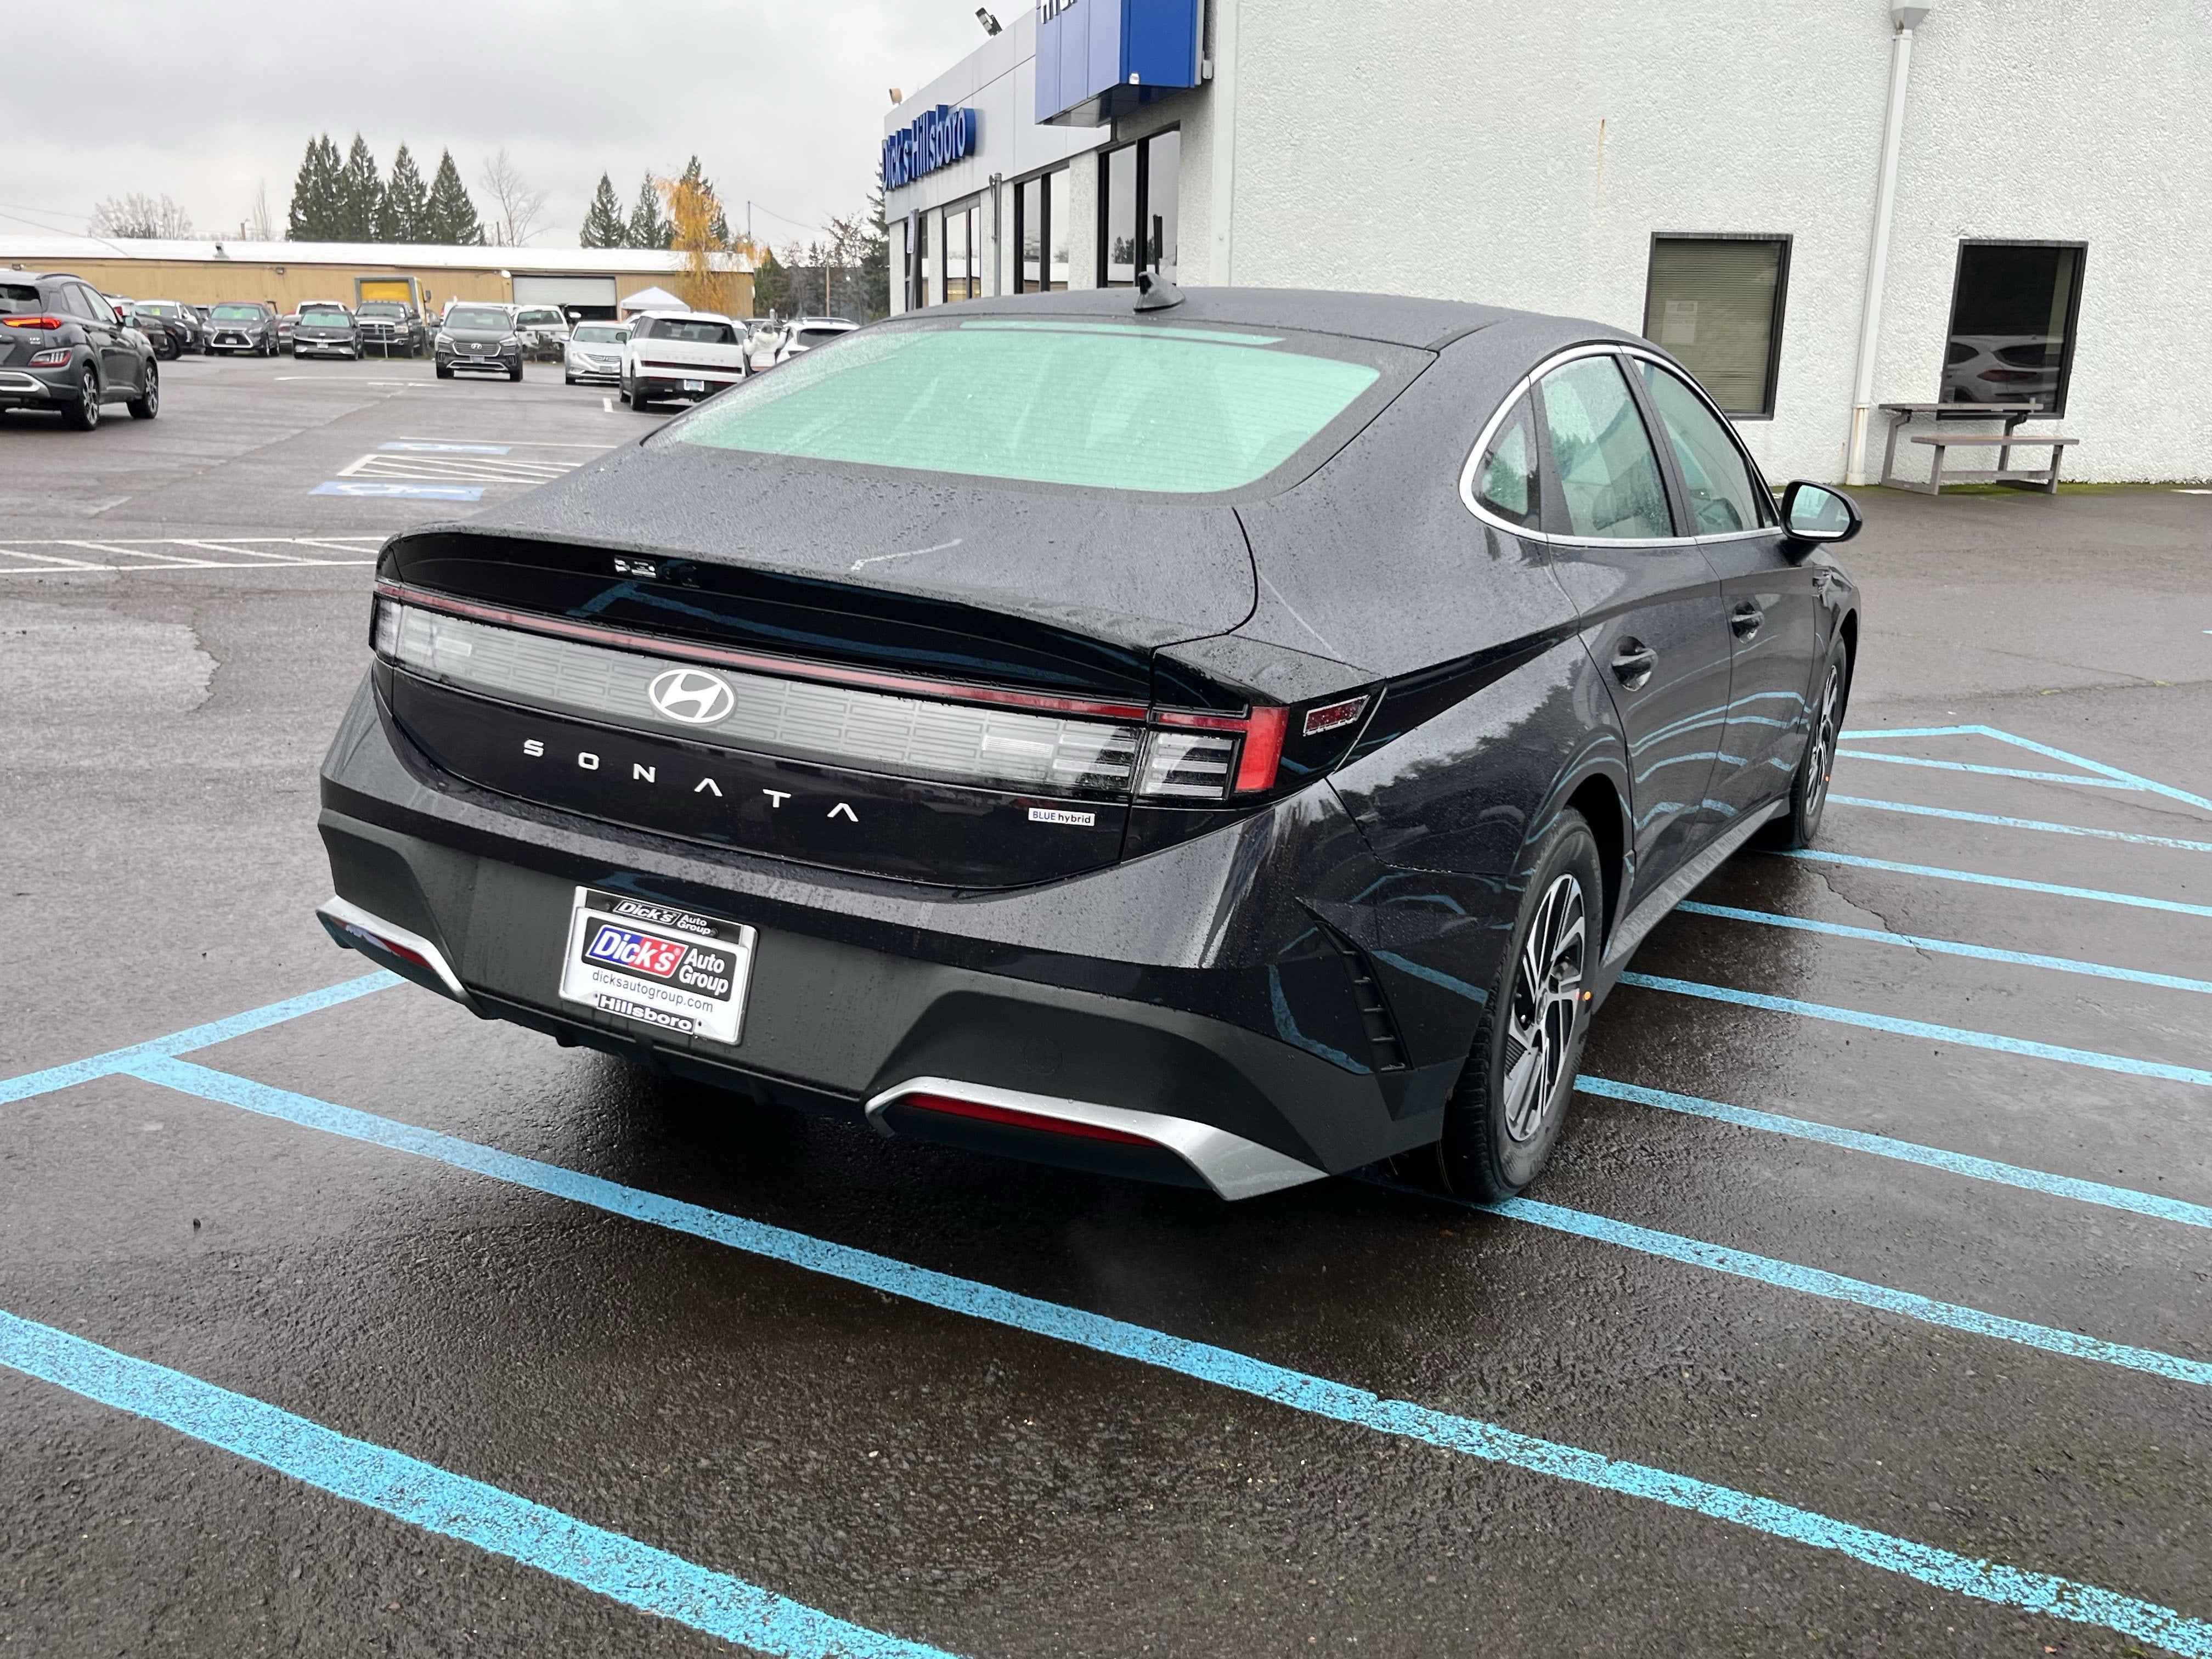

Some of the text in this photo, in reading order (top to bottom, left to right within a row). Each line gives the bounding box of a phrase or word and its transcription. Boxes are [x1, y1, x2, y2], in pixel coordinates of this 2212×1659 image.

[882, 104, 967, 191] Dick's Hillsboro
[523, 738, 859, 822] SONATA
[1032, 811, 1091, 823] BLUE hybrid
[618, 901, 708, 927] Dick's Auto
[676, 920, 711, 935] Group
[593, 930, 725, 974] Dick's Auto
[592, 970, 713, 1013] dicksautogroup.com
[679, 964, 729, 996] Group
[600, 995, 693, 1031] Hillsboro
